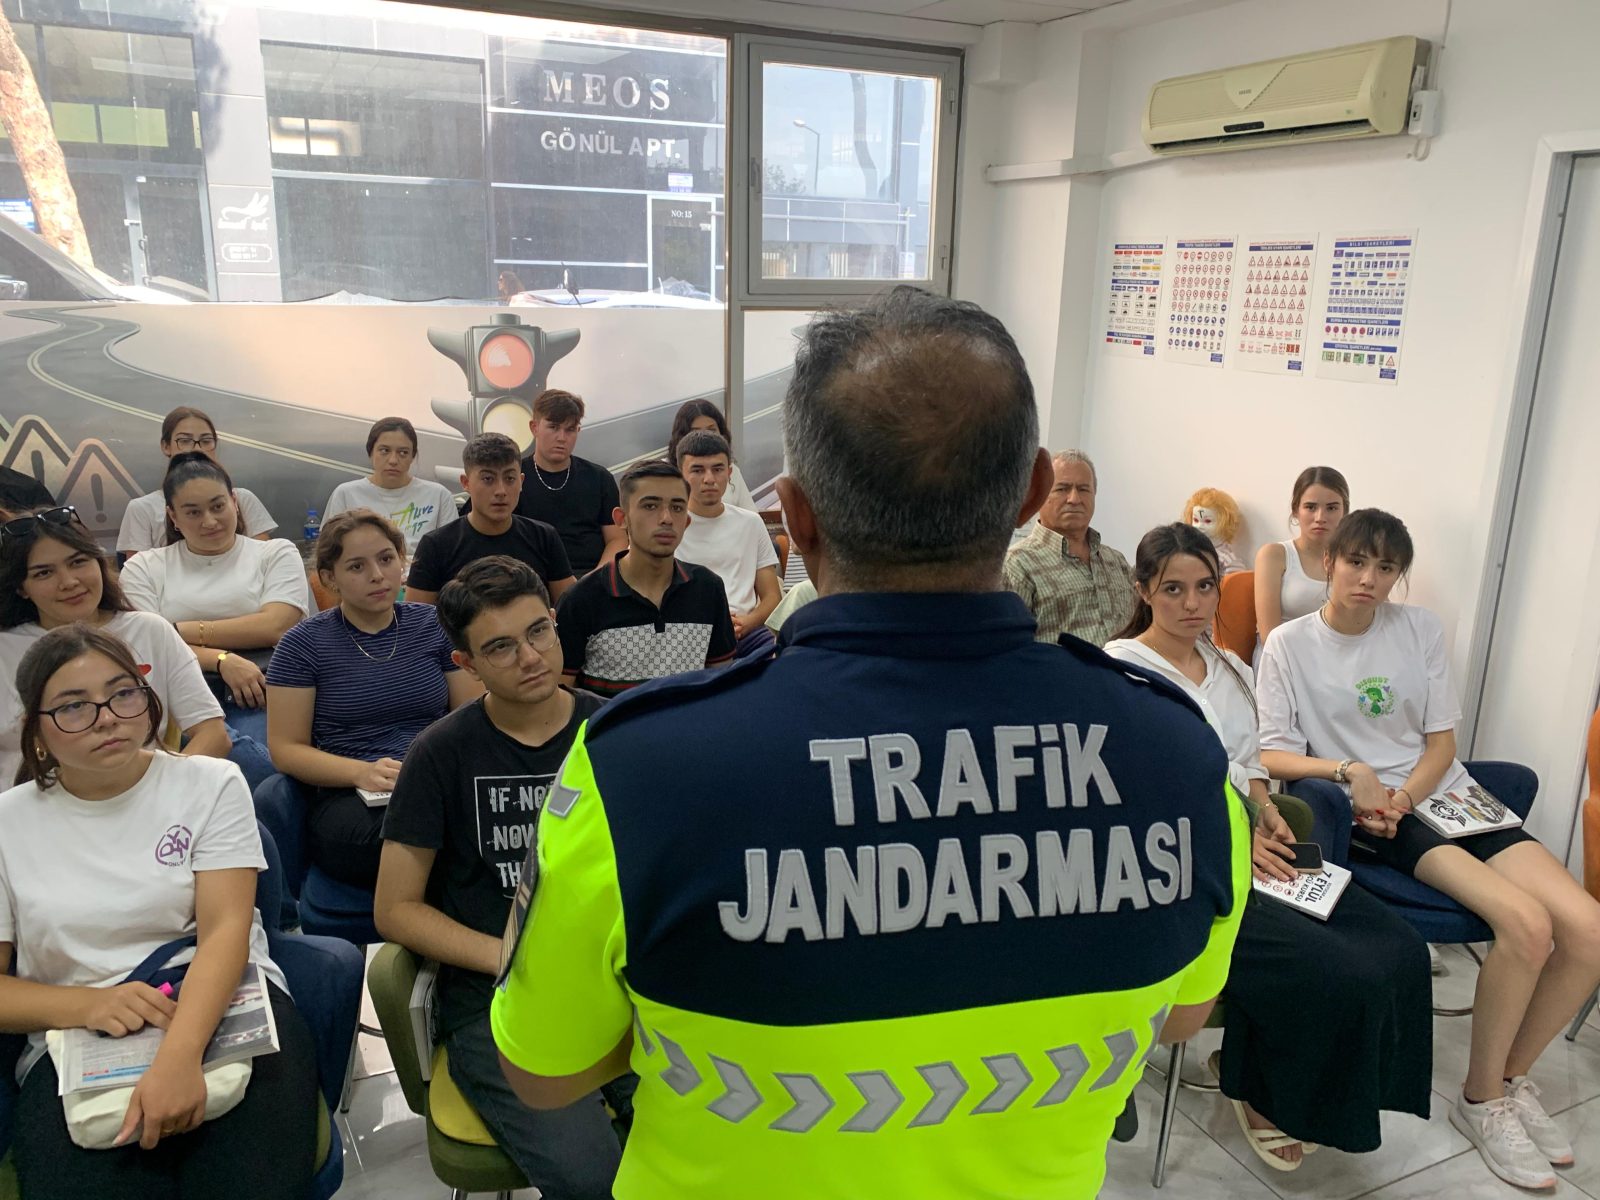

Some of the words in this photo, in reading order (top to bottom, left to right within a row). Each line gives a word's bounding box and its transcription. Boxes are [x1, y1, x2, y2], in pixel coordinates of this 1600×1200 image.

[543, 70, 671, 111] MEOS
[540, 127, 623, 155] GÖNÜL
[628, 136, 681, 159] APT.
[489, 787, 511, 813] IF
[518, 785, 549, 812] NO
[496, 861, 526, 888] TH
[717, 817, 1192, 943] JANDARMASI
[1304, 877, 1328, 903] EYLÜL
